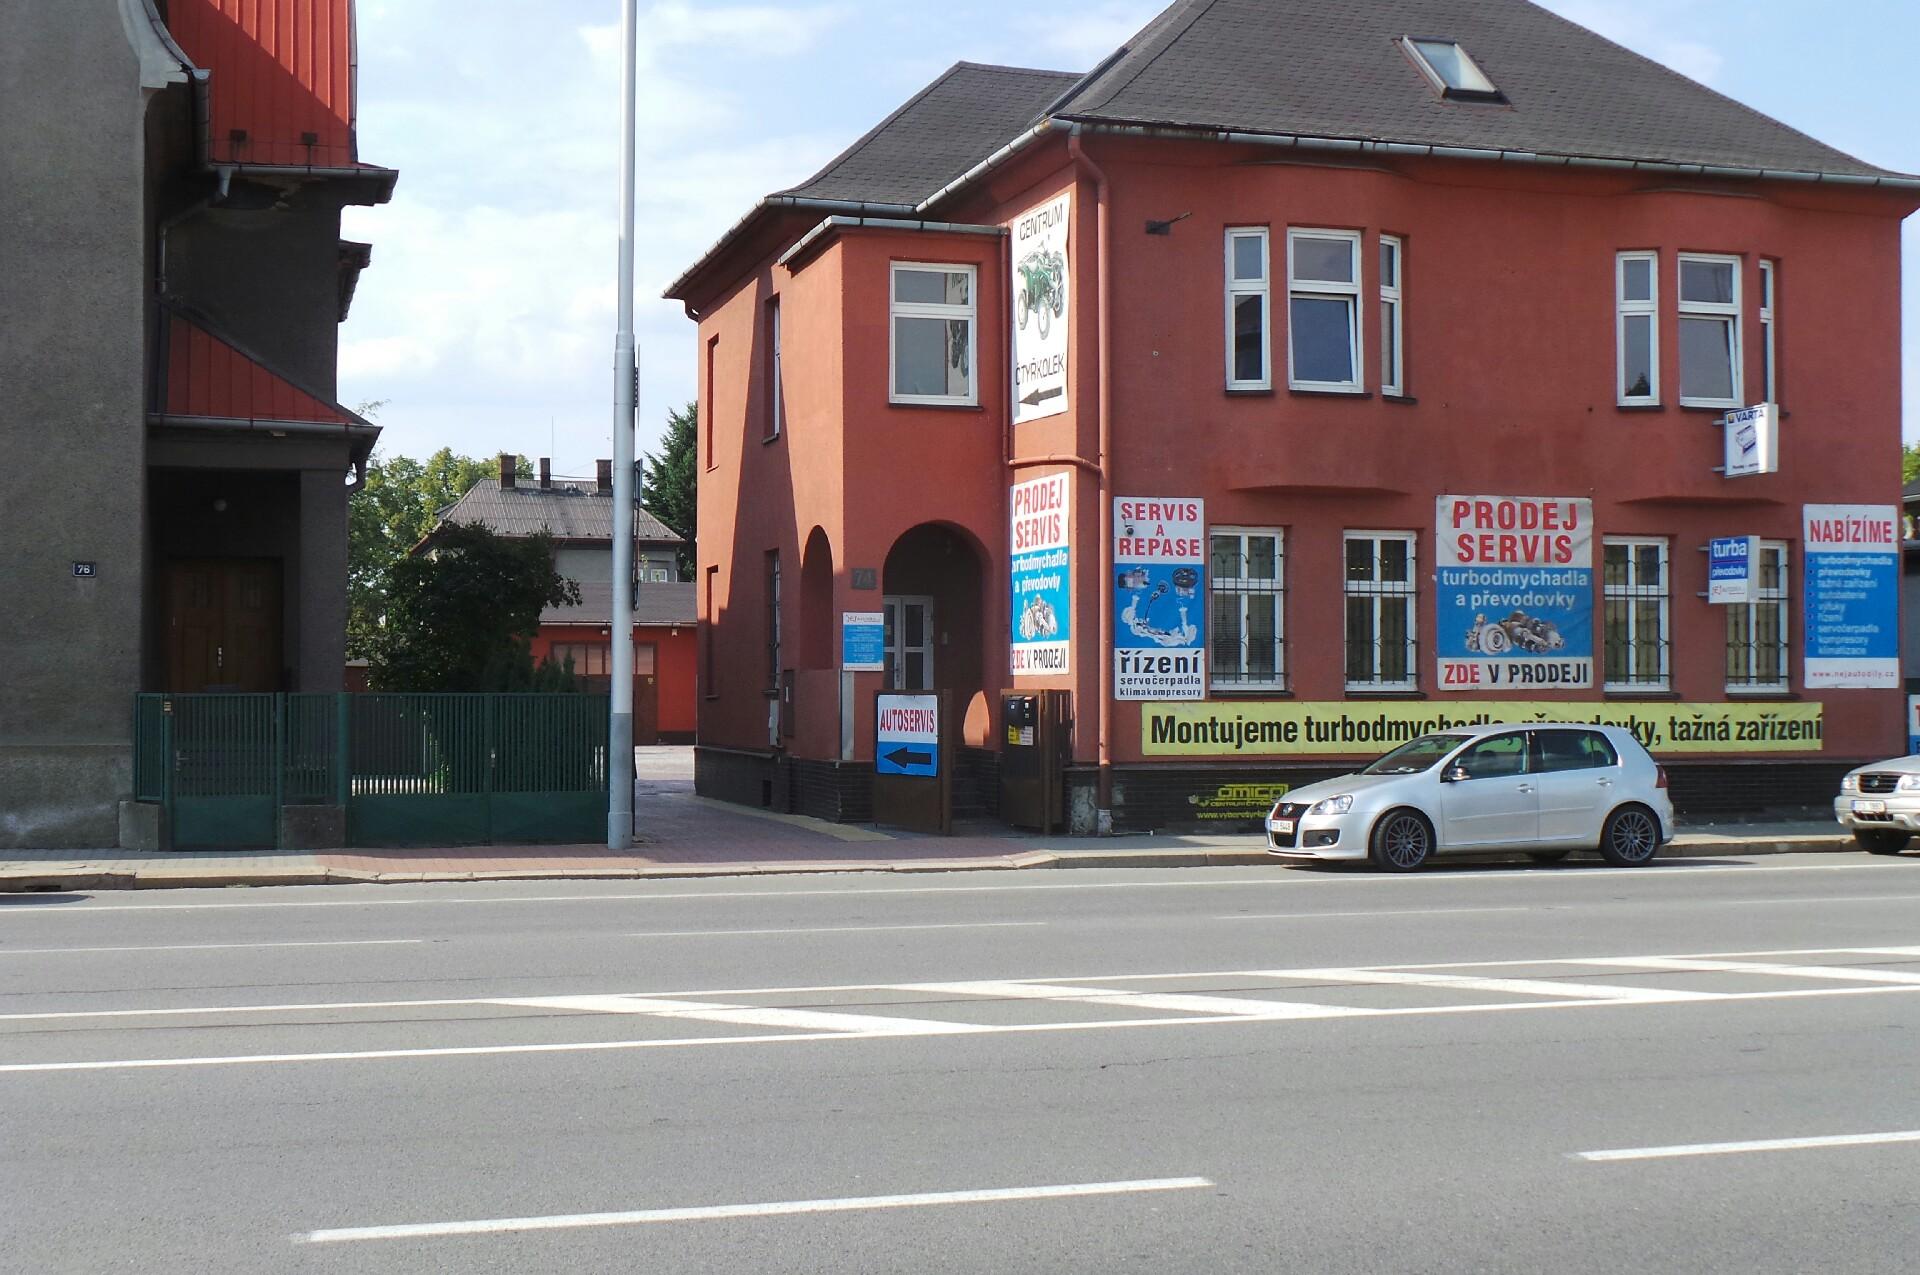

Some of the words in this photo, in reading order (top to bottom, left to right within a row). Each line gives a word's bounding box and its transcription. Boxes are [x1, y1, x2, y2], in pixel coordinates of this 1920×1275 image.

[1020, 203, 1063, 241] CENTRUM
[1016, 353, 1065, 386] ČTYŘKOLEK
[1736, 409, 1764, 422] VARTA
[1015, 479, 1063, 517] PRODEJ
[1121, 503, 1198, 522] SERVIS
[1452, 500, 1577, 531] PRODEJ
[1016, 513, 1060, 549] SERVIS
[1156, 524, 1165, 536] A
[1810, 515, 1892, 543] NABÍZÍME
[1119, 538, 1201, 557] REPASE
[1457, 533, 1573, 563] SERVIS
[1713, 539, 1747, 557] turba
[1015, 580, 1020, 593] a
[1442, 570, 1588, 589] turbodmychadla
[1456, 594, 1466, 606] a
[1471, 590, 1576, 610] převodovky
[1034, 648, 1066, 668] PRODEJI
[1120, 650, 1200, 674] řízení
[1120, 675, 1201, 687] servočerpadla
[1444, 664, 1480, 684] ZDE
[1488, 664, 1500, 683] V
[1508, 663, 1588, 683] PRODEJI
[1120, 687, 1201, 698] klimakompresory
[880, 709, 935, 733] AUTOSERVIS
[1151, 714, 1298, 749] Montujeme
[1669, 713, 1730, 741] tažná
[1735, 713, 1823, 741] zařízení
